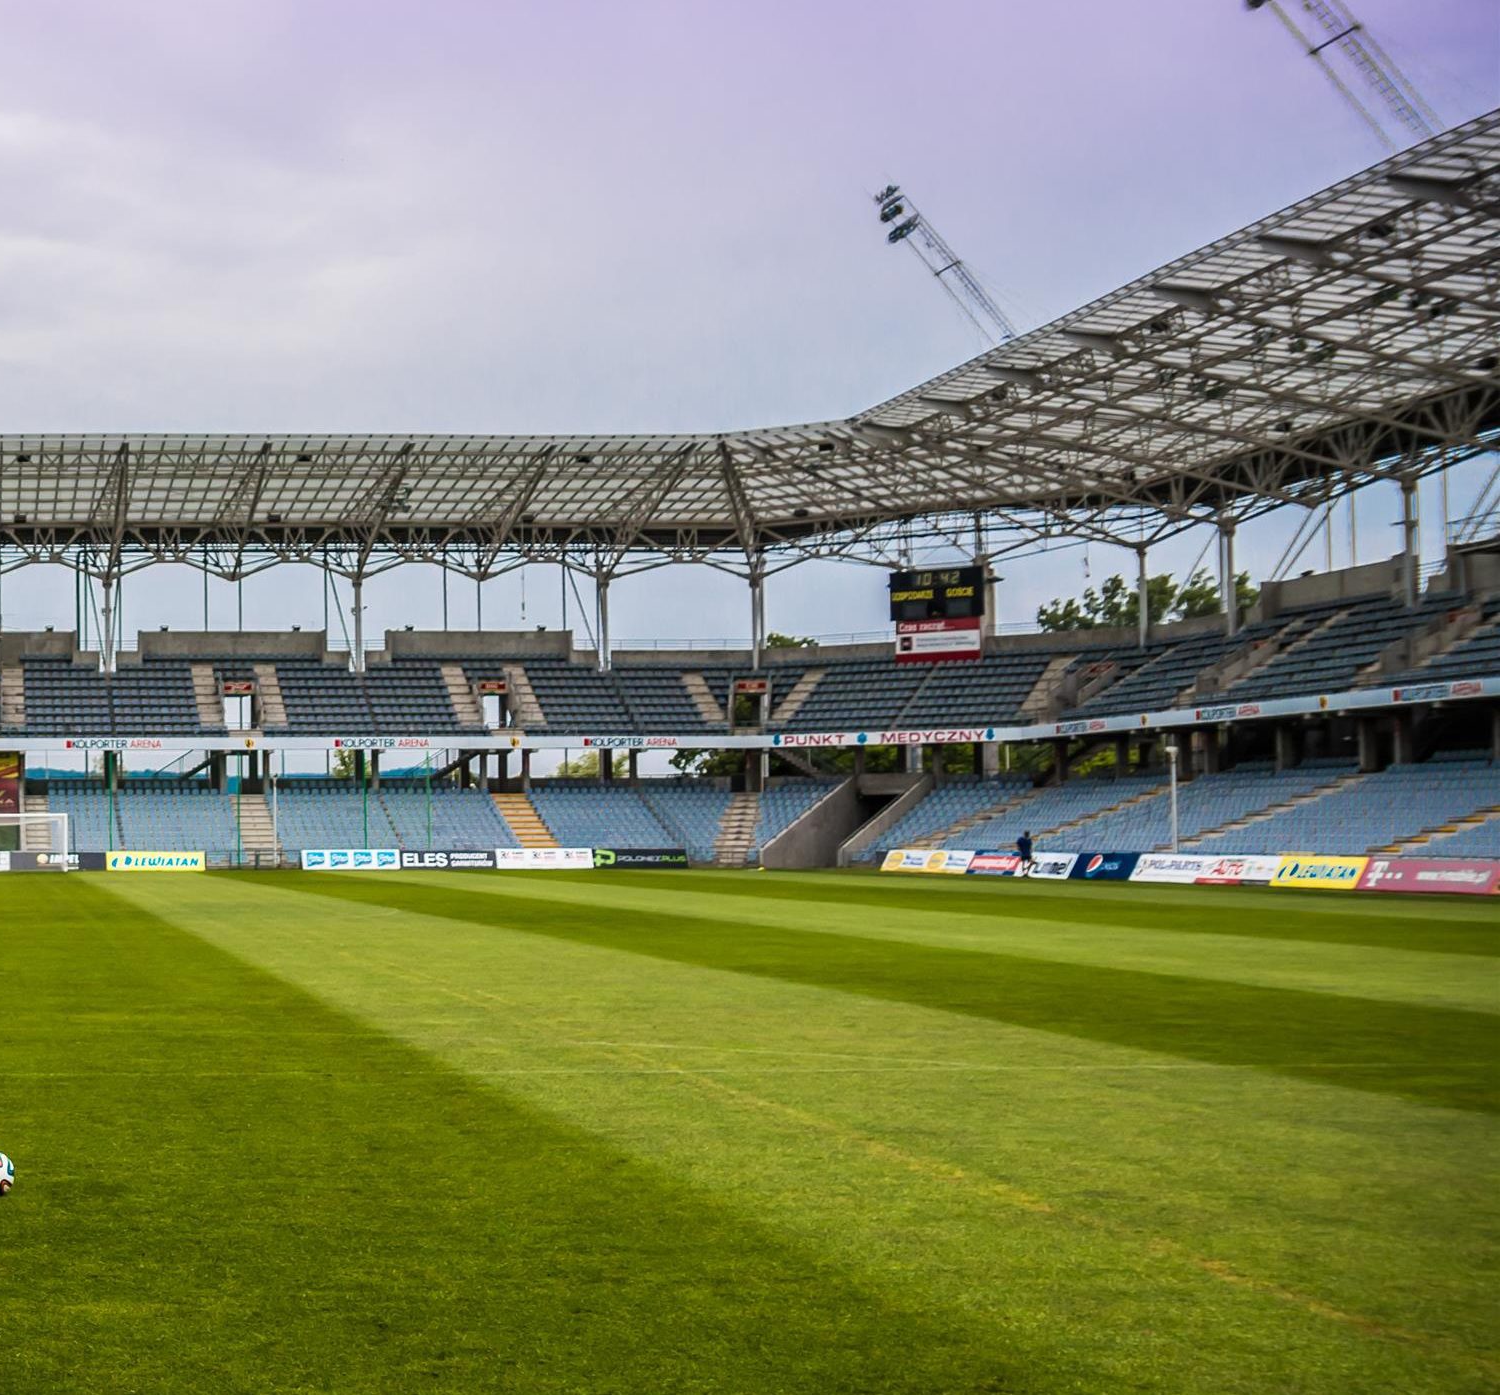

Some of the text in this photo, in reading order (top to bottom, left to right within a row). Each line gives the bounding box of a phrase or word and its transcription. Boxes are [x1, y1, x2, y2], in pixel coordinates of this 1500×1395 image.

[591, 738, 677, 746] KOLPORTER ARENA
[784, 730, 985, 745] PUNKT MEDYCZNY
[73, 740, 161, 748] KOLPORTER ARENA
[341, 739, 430, 747] KOLPORTER ARENA
[134, 857, 199, 867] LEWIATAN
[402, 853, 449, 867] ELES
